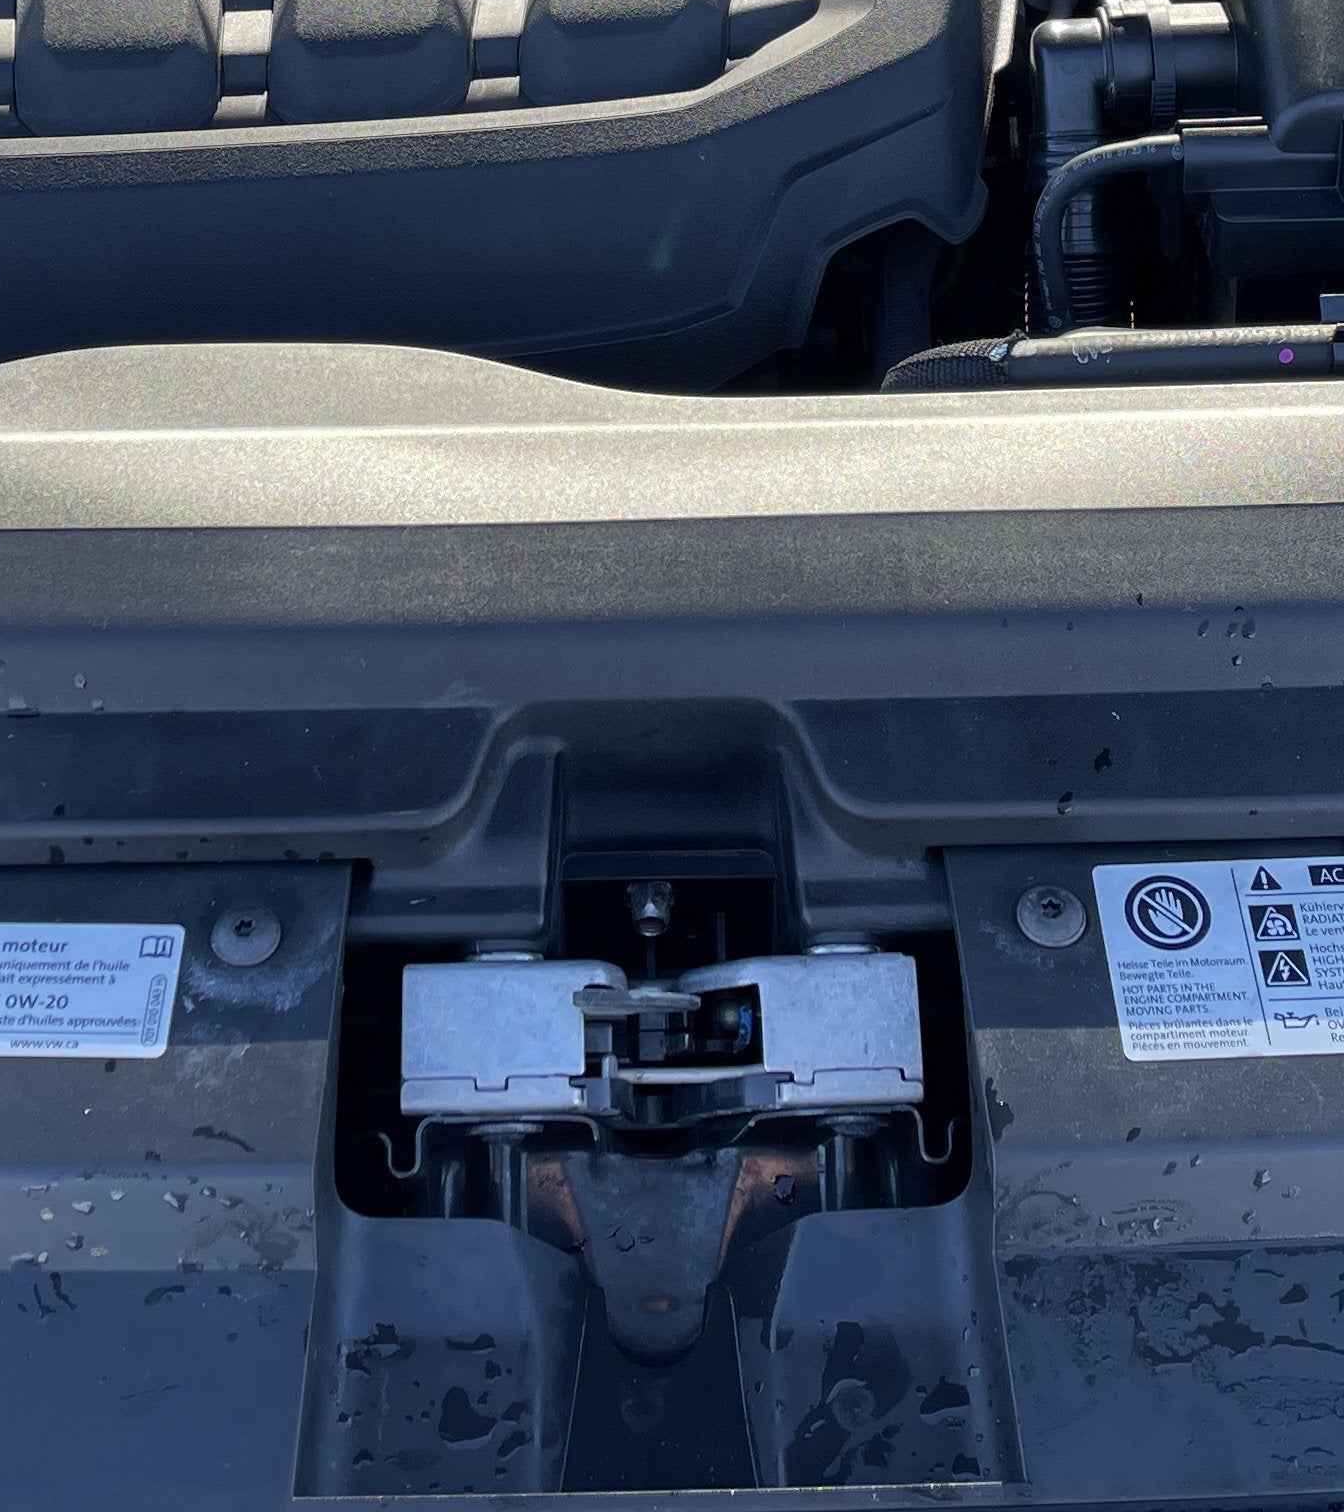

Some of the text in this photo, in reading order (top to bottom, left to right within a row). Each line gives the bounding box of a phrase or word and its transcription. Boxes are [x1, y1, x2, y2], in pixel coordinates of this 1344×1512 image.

[2, 940, 69, 953] moteur
[1312, 954, 1344, 966] HIGH
[74, 962, 89, 971] de
[93, 961, 129, 972] l'huile
[18, 976, 104, 987] expressément
[1122, 982, 1215, 994] HOT PARTS IN THE
[5, 995, 69, 1010] 0W-20
[1125, 994, 1165, 1005] ENGINE
[1126, 1005, 1172, 1016] MOVING
[18, 1016, 64, 1026] d'huiles
[10, 1037, 79, 1049] www.vw.ca
